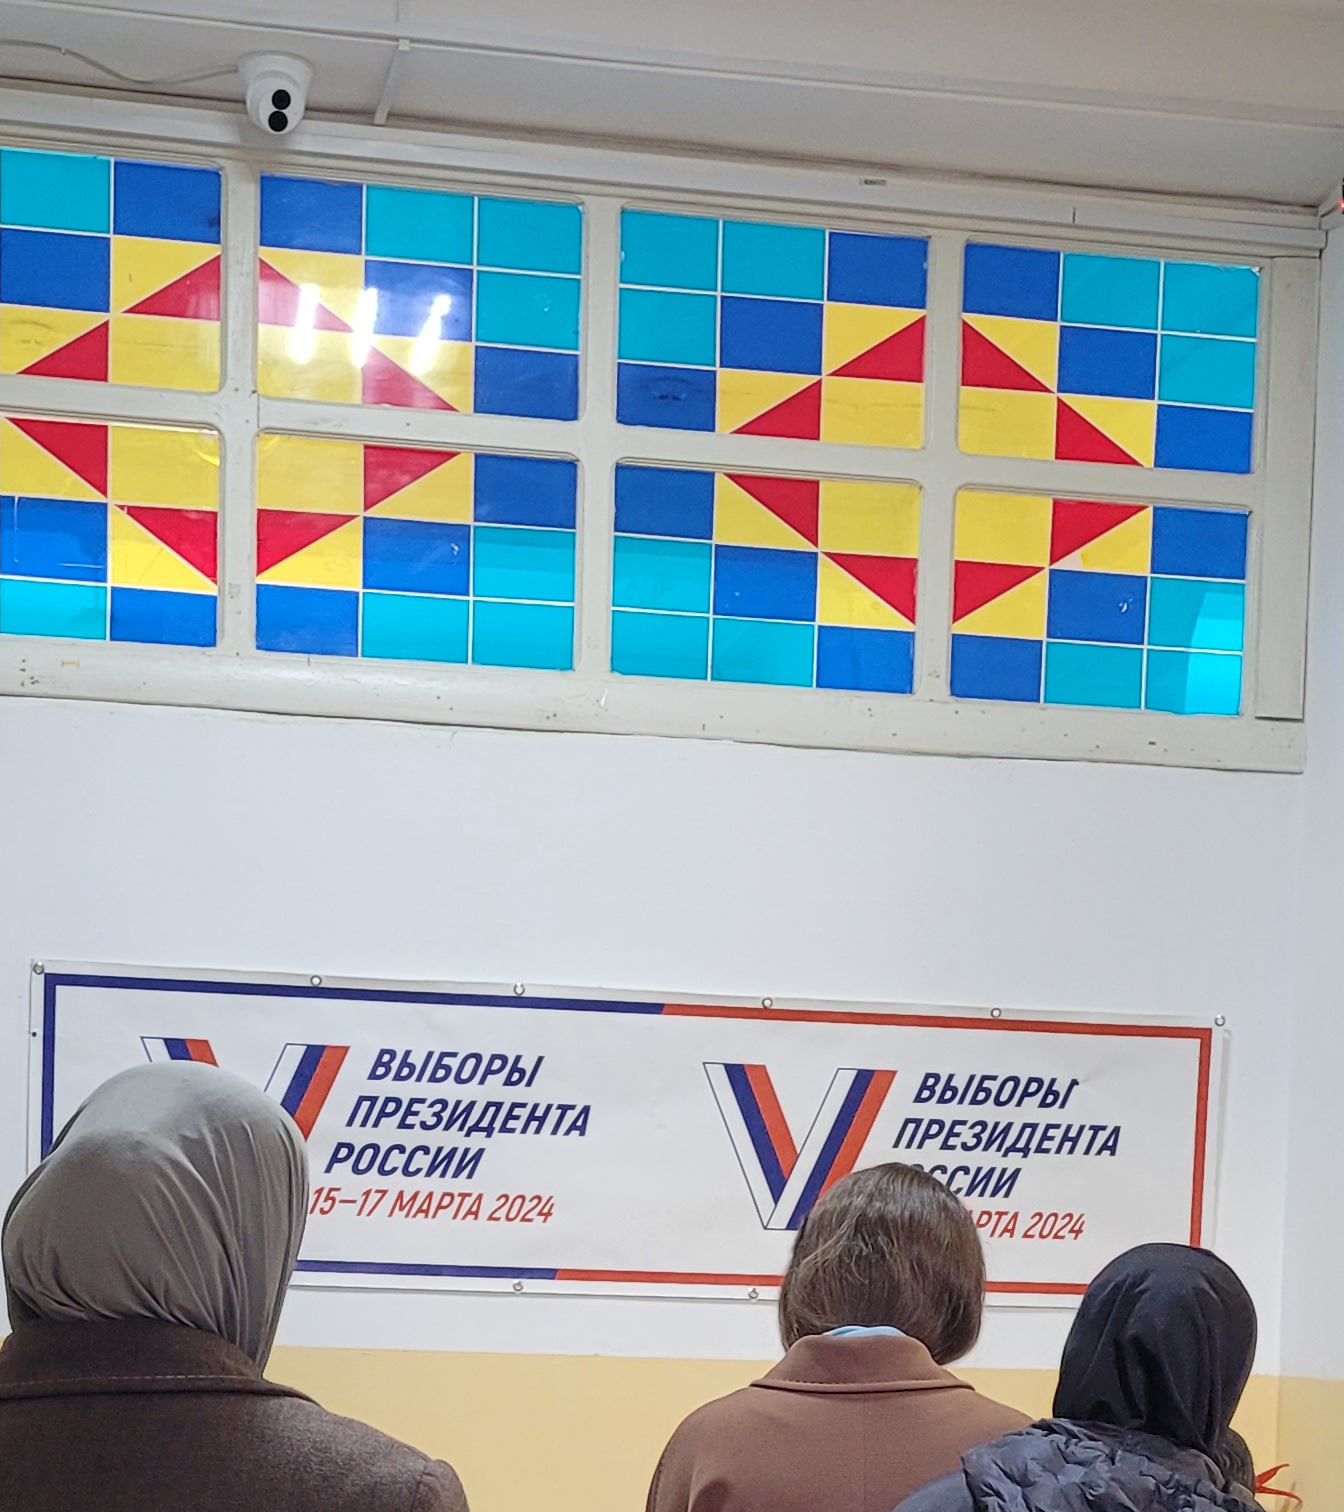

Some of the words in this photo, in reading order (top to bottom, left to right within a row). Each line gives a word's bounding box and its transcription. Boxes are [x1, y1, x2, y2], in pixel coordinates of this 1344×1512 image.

[367, 1048, 545, 1088] ВЫБОРЫ
[912, 1071, 1080, 1110] ВЫБОРЫ
[346, 1095, 592, 1138] ПРЕЗИДЕНТА
[892, 1117, 1122, 1158] ПРЕЗИДЕНТА
[323, 1142, 486, 1180] РОССИИ
[389, 1190, 483, 1222] МАРТА
[487, 1193, 555, 1224] 2024
[968, 1209, 1020, 1239] РТА
[1022, 1211, 1086, 1240] 2024
